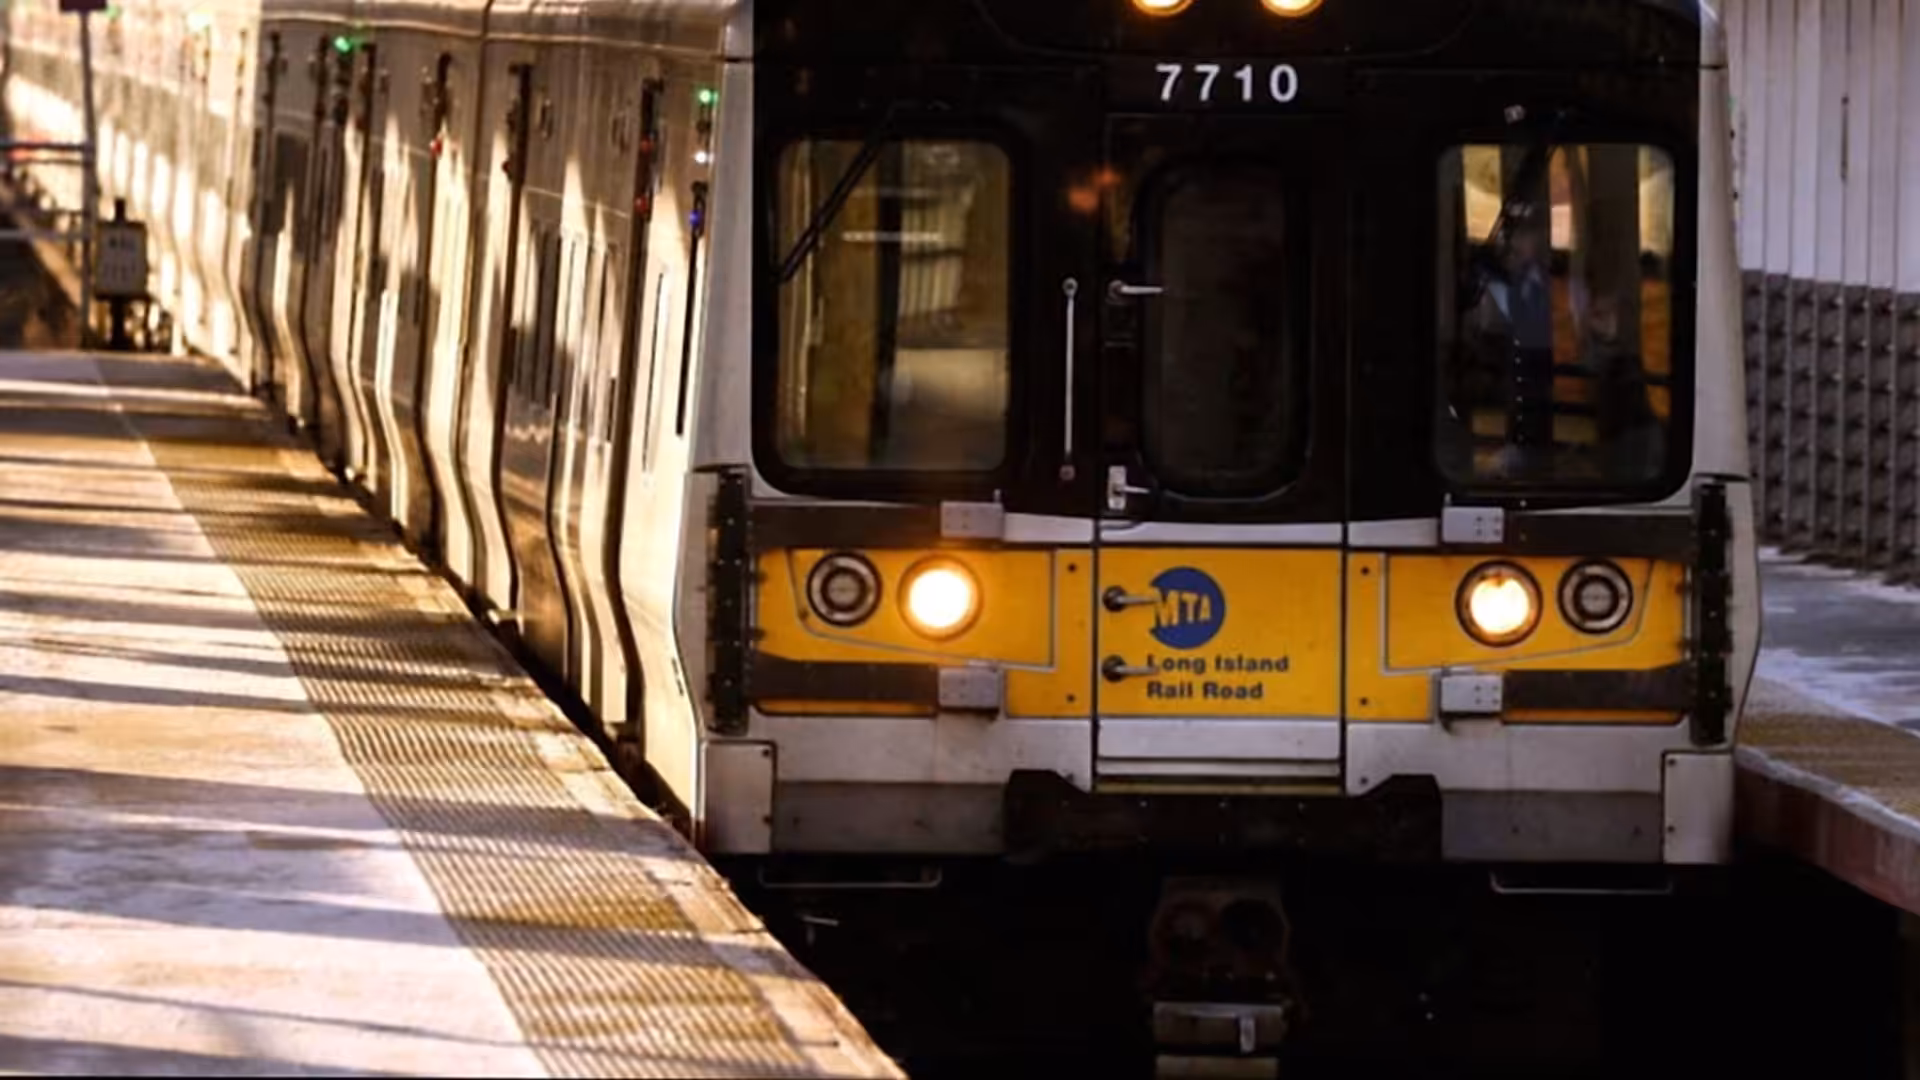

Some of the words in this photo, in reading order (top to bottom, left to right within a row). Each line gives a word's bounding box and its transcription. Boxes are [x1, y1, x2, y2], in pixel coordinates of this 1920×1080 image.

[1155, 63, 1299, 102] 7710
[1152, 588, 1212, 627] MTA
[1147, 654, 1206, 674] Long
[1215, 654, 1289, 672] Island
[1147, 681, 1194, 699] Rail
[1202, 681, 1263, 699] Road
